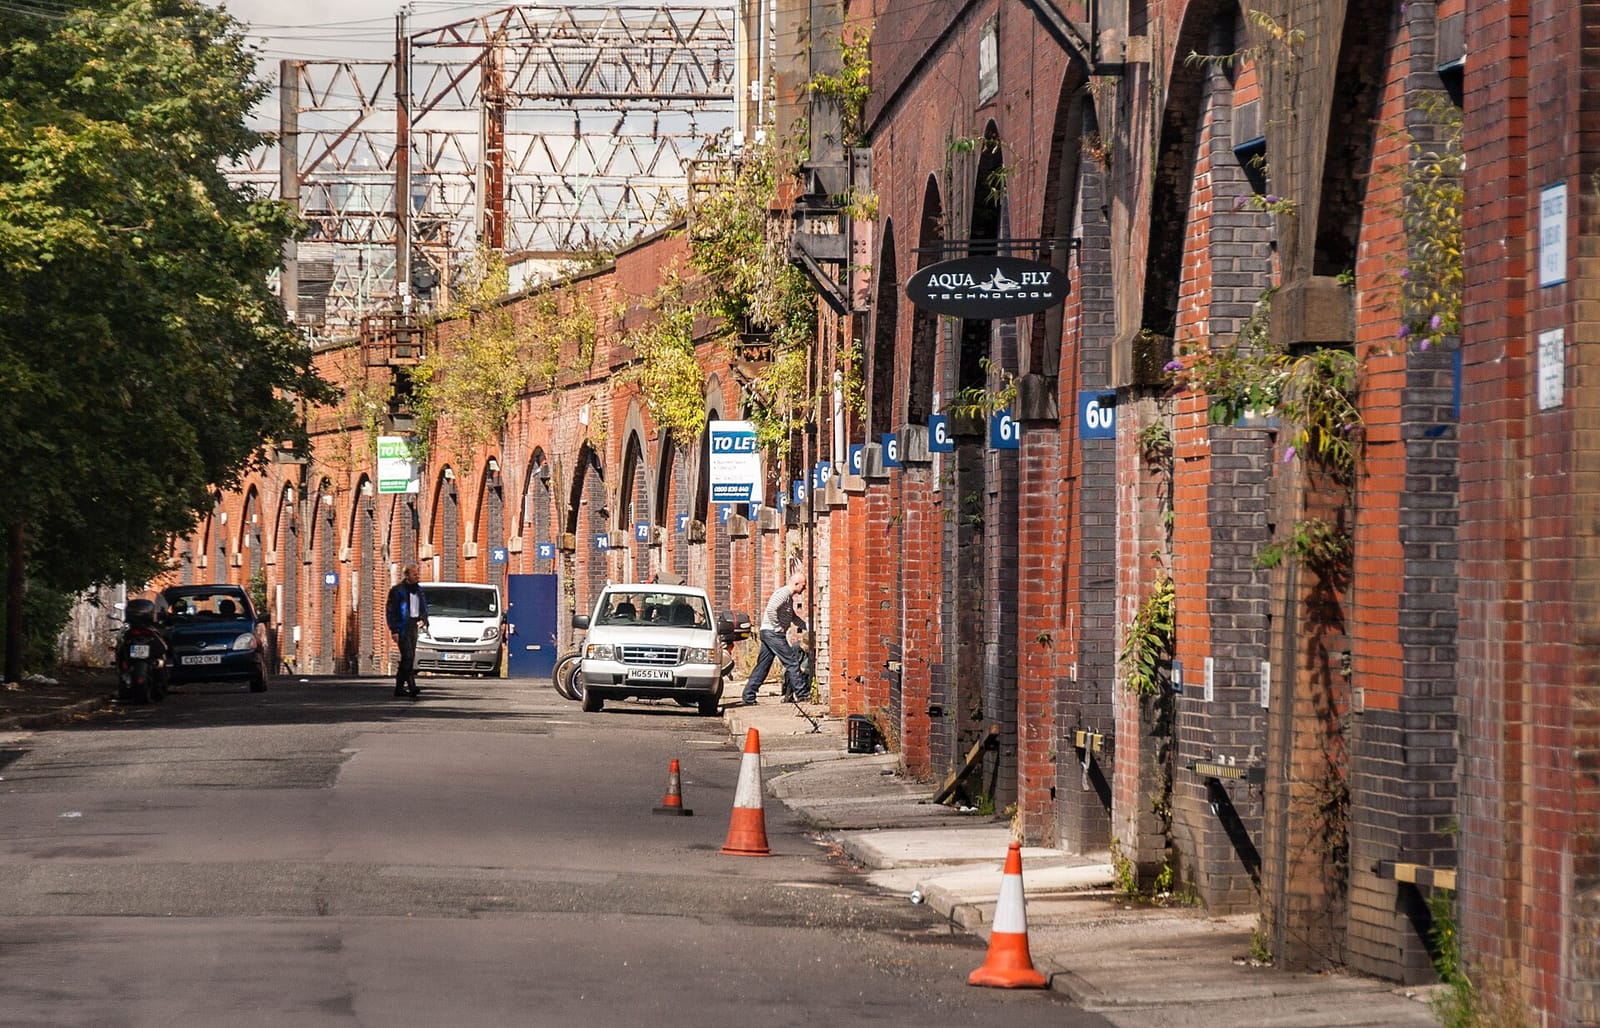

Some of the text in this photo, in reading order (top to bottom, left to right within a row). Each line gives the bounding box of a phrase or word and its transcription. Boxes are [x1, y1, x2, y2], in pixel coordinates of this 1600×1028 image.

[927, 272, 1051, 289] AQUA FLY
[928, 292, 1052, 300] TECHNOLOGY
[1086, 400, 1113, 429] 60
[713, 436, 732, 450] TO
[638, 525, 648, 537] 73
[597, 537, 608, 548] 74
[494, 550, 504, 561] 76
[540, 545, 550, 556] 75
[631, 670, 669, 679] HG55 LVN
